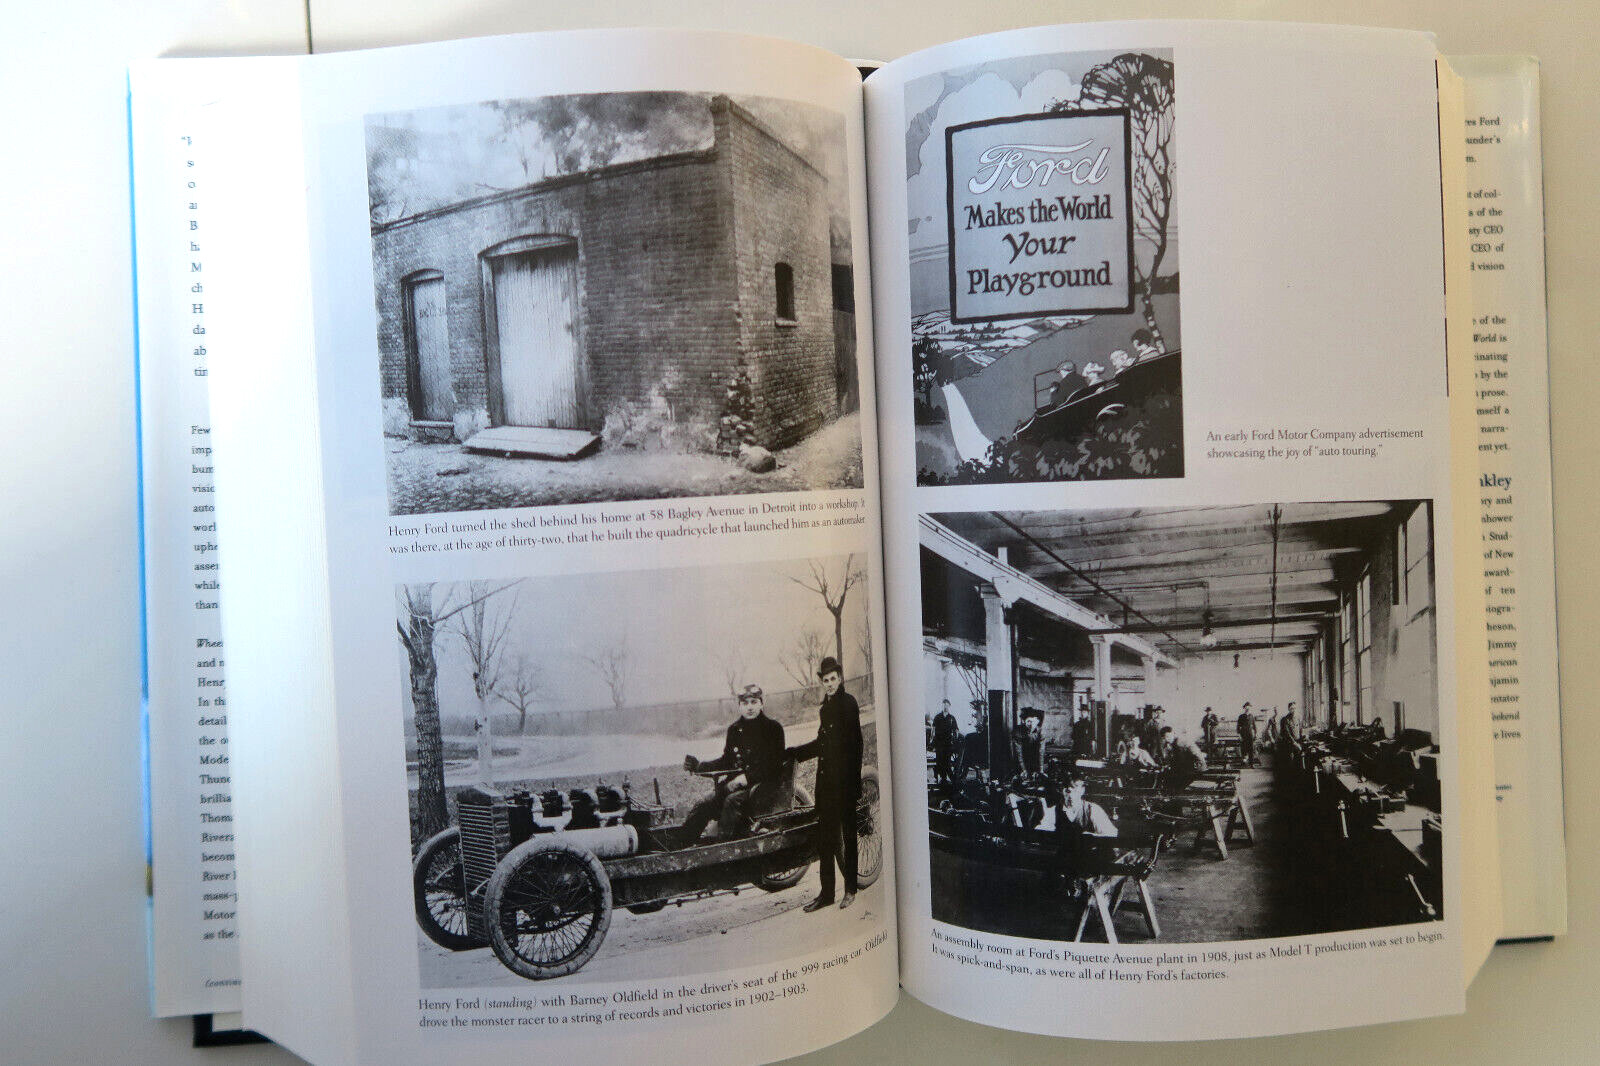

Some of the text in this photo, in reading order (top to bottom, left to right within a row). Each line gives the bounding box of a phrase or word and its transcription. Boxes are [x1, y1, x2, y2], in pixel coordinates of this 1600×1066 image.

[1480, 117, 1500, 126] Ford
[968, 137, 1110, 194] Ford
[964, 194, 1113, 230] Makes the World
[1477, 208, 1485, 216] of
[1483, 226, 1503, 234] CEO
[1002, 232, 1076, 264] Your
[1471, 243, 1504, 252] CEO of
[967, 261, 1113, 296] Playground
[1481, 370, 1508, 381] by the
[1207, 428, 1423, 444] An early Ford Motor Company advertisement
[1207, 444, 1383, 460] showcasing the joy of "auto touring."
[1496, 496, 1512, 504] and
[389, 525, 420, 536] Henry
[425, 523, 448, 534] Ford
[451, 521, 486, 532] turned
[490, 519, 507, 530] the
[512, 516, 536, 528] shed
[541, 513, 576, 527] behind
[582, 512, 596, 524] his
[601, 512, 632, 524] home
[636, 513, 645, 521] at
[650, 510, 663, 520] 58
[668, 508, 702, 522] Bagley
[707, 506, 744, 517] Avenue
[750, 505, 758, 514] in
[763, 502, 796, 514] Detroit
[800, 502, 816, 511] into
[389, 545, 408, 553] was
[412, 542, 441, 553] there,
[444, 542, 453, 550] at
[457, 541, 472, 550] the
[475, 540, 493, 550] age
[496, 537, 506, 547] of
[509, 535, 564, 546] thirty-two,
[568, 532, 587, 543] that
[592, 530, 604, 541] he
[608, 528, 632, 541] built
[636, 529, 653, 539] the
[656, 524, 717, 540] quadricycle
[721, 524, 741, 534] that
[744, 519, 789, 531] launched
[792, 518, 809, 528] him
[1496, 550, 1514, 558] New
[197, 658, 216, 667] and
[198, 677, 225, 689] Henr
[199, 736, 215, 745] the
[200, 814, 232, 822] Thom
[204, 911, 235, 920] Motor
[218, 930, 234, 938] the
[931, 929, 942, 939] An
[944, 934, 984, 951] assembly
[987, 945, 1012, 955] room
[1016, 947, 1025, 957] at
[1029, 948, 1059, 960] Ford's
[1064, 951, 1109, 965] Piquette
[1113, 954, 1152, 964] Avenue
[1157, 954, 1183, 966] plant
[1188, 954, 1197, 963] in
[1202, 952, 1230, 963] 1908,
[1234, 950, 1252, 963] just
[1270, 946, 1301, 958] Model
[1305, 945, 1312, 955] T
[1315, 940, 1367, 957] production
[1369, 939, 1387, 947] was
[1390, 936, 1403, 945] set
[1406, 935, 1415, 944] to
[932, 944, 1229, 983] It was spick-and-span, as were all of Henry Ford's factories.
[419, 998, 450, 1011] Henry
[456, 998, 480, 1009] Ford
[485, 996, 537, 1010] (standing)
[542, 995, 565, 1006] with
[571, 994, 608, 1007] Barney
[613, 989, 658, 1002] Oldfield
[663, 988, 674, 999] in
[678, 986, 697, 997] the
[701, 979, 738, 995] driver's
[743, 978, 763, 989] seat
[768, 971, 778, 983] of
[782, 968, 797, 981] the
[802, 962, 819, 975] 999
[822, 954, 848, 969] racing
[419, 1017, 447, 1027] drove
[452, 1015, 469, 1026] the
[472, 1016, 514, 1026] monster
[518, 1017, 544, 1025] racer
[548, 1016, 559, 1024] to
[571, 1013, 602, 1024] string
[605, 1011, 616, 1021] of
[619, 1006, 660, 1021] records
[663, 1005, 683, 1016] and
[687, 999, 732, 1014] victories
[735, 998, 745, 1007] in
